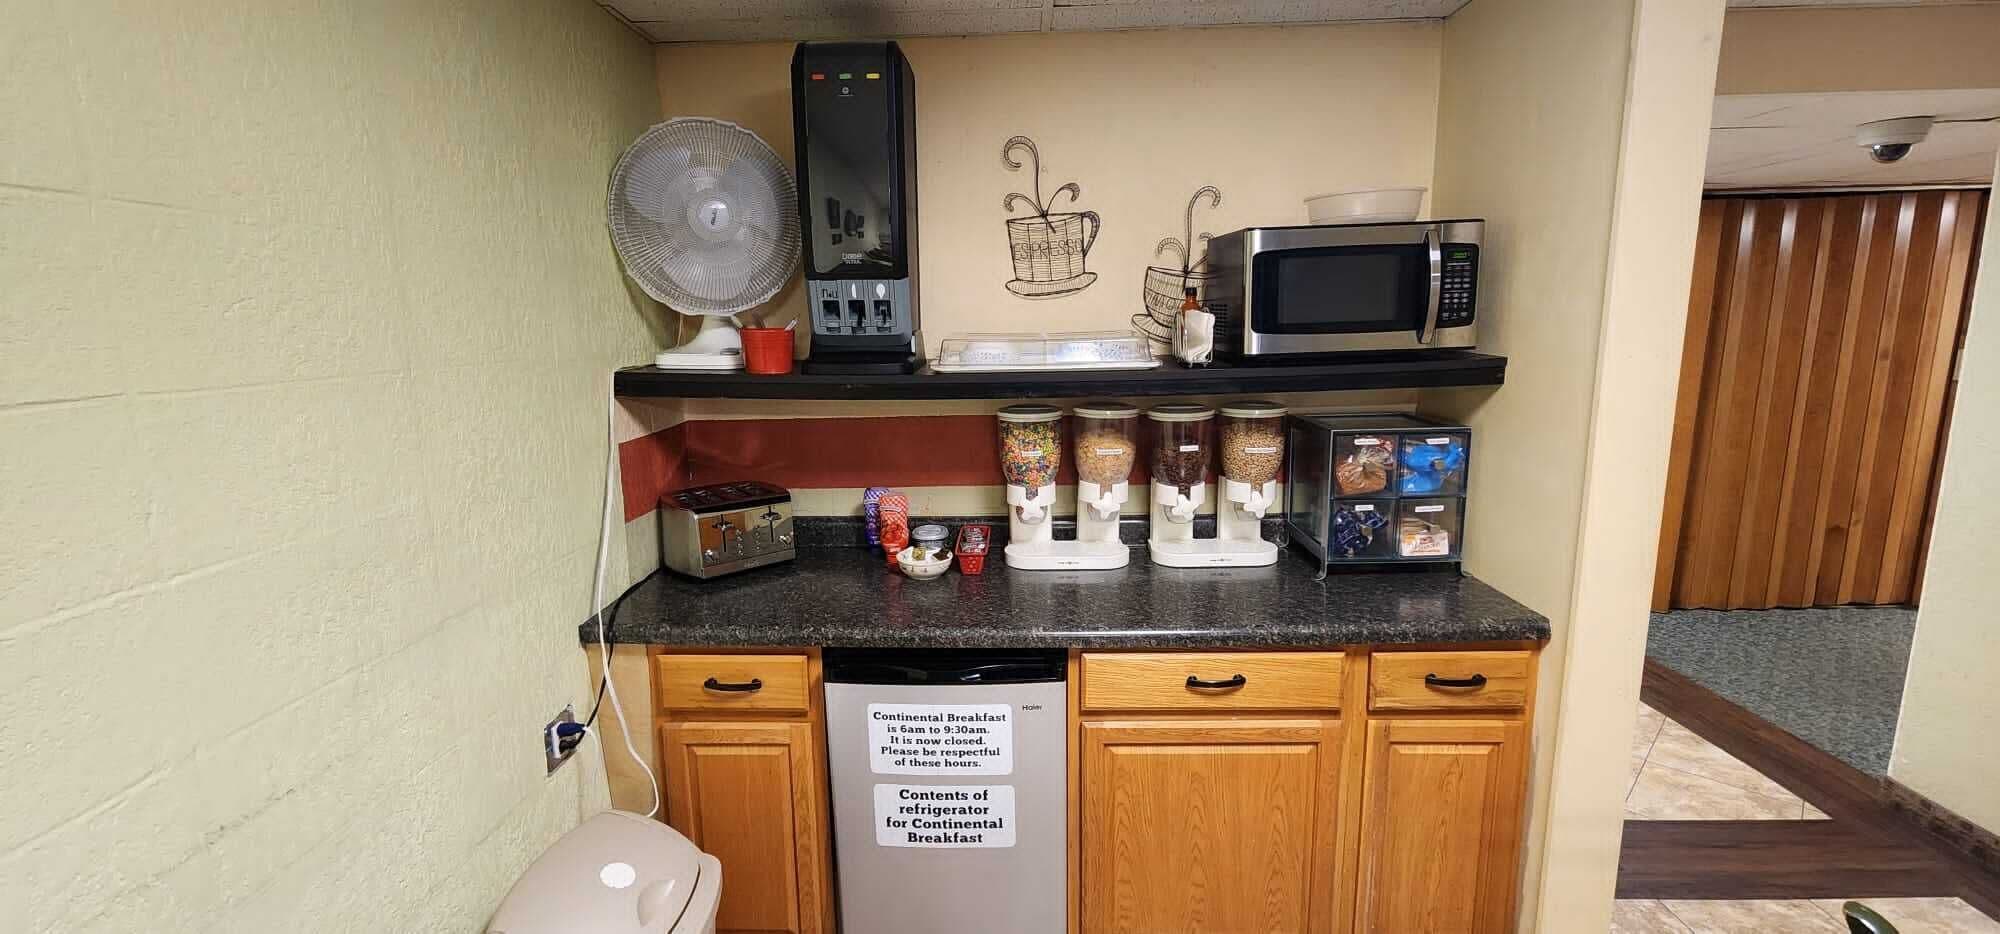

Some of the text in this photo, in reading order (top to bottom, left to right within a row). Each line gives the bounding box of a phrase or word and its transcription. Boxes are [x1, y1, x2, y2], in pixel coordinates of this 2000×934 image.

[1014, 238, 1082, 259] ESPRESSO
[873, 711, 1006, 723] Continental Breakfast
[887, 724, 990, 735] is 6am to 9:30am.
[890, 735, 899, 744] It
[902, 736, 913, 745] is
[944, 736, 987, 746] closed.
[881, 746, 1001, 758] Please be respectful
[895, 758, 982, 767] of these hours.
[899, 789, 989, 801] Contents of
[899, 803, 990, 818] refrigerator
[886, 816, 1004, 829] for Continental
[907, 832, 983, 844] Breakfast
